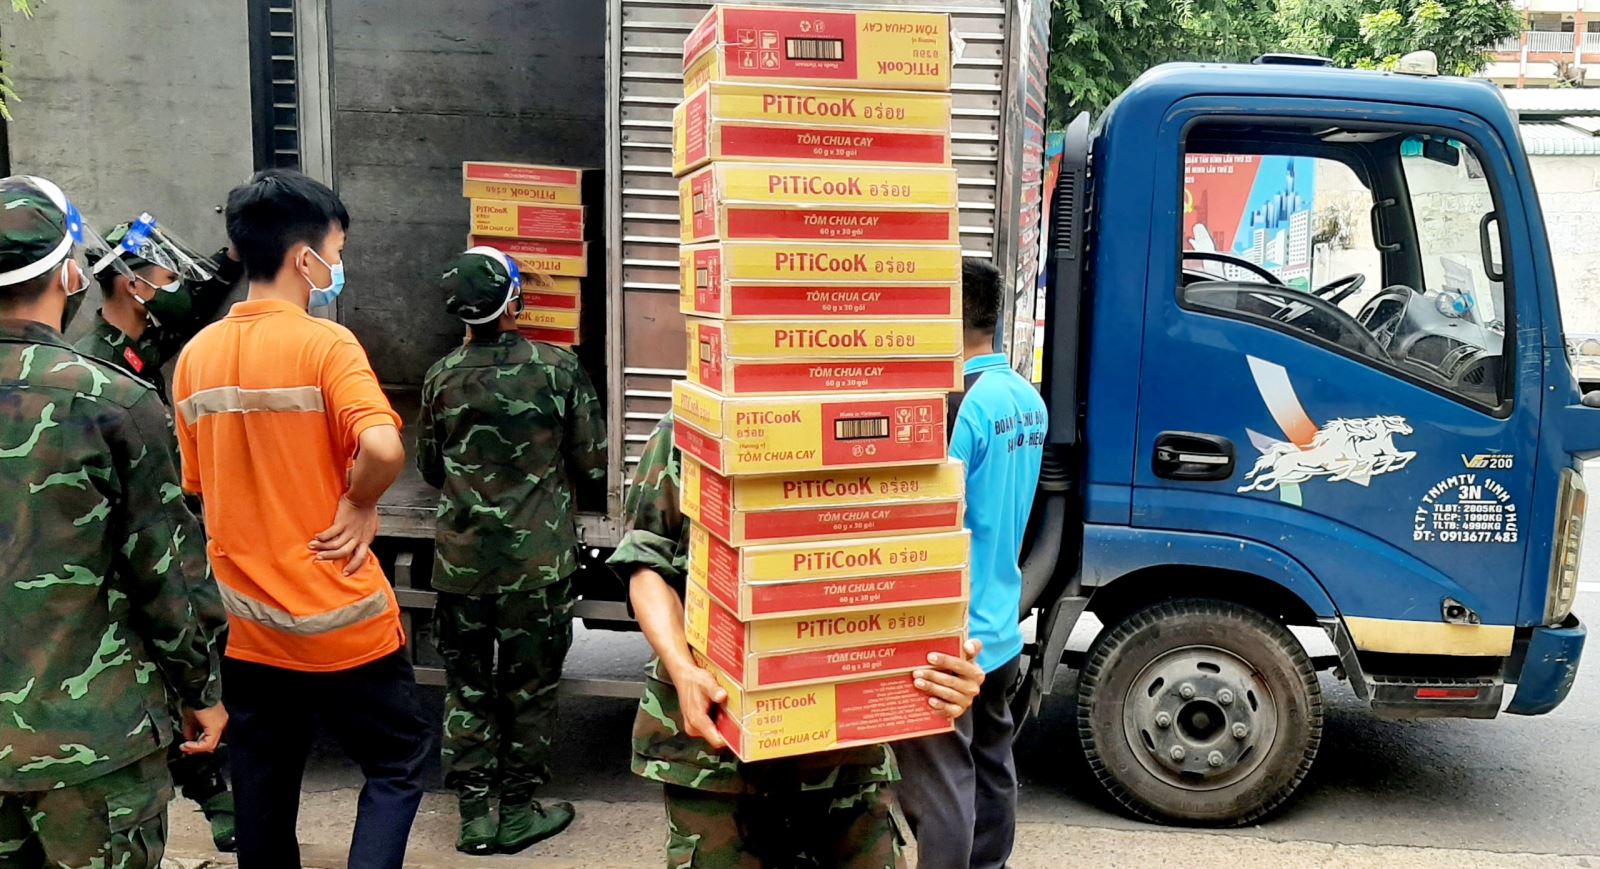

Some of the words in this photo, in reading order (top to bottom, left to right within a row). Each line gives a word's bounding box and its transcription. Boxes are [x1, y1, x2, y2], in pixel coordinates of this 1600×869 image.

[863, 23, 882, 32] CAY
[886, 23, 913, 33] CHUA
[916, 25, 937, 35] TÔM
[797, 134, 820, 145] TÔM
[822, 136, 851, 146] CHUA
[854, 137, 873, 147] CAY
[804, 214, 826, 224] TÔM
[829, 216, 857, 225] CHUA
[860, 217, 878, 226] CAY
[522, 260, 560, 270] PiTiCo
[806, 290, 829, 301] TÔM
[831, 292, 858, 301] CHUA
[862, 292, 881, 301] CAY
[809, 367, 832, 377] TÔM
[834, 368, 861, 376] CHUA
[864, 367, 884, 376] CAY
[738, 452, 762, 462] TÔM
[764, 450, 793, 461] CHUA
[796, 450, 816, 460] CAY
[1489, 459, 1513, 468] 200
[1458, 485, 1482, 500] 3N
[1434, 504, 1461, 512] TLBT:
[1463, 504, 1502, 513] 2805KG
[818, 512, 840, 522] TÔM
[842, 512, 870, 521] CHUA
[872, 510, 890, 519] CAY
[1414, 506, 1428, 530] CTY
[1432, 513, 1461, 521] TLCP:
[1464, 514, 1502, 522] 1990KG
[1462, 522, 1501, 530] 4990KG
[1413, 530, 1435, 541] ĐT:
[1440, 531, 1518, 542] 0913677.483
[824, 584, 846, 595] TÔM
[848, 584, 875, 592] CHUA
[877, 581, 896, 590] CAY
[827, 654, 849, 664] TÔM
[850, 651, 876, 660] CHUA
[878, 648, 896, 658] CAY
[758, 737, 780, 749] TÔM
[783, 733, 810, 745] CHUA
[812, 729, 831, 740] CAY
